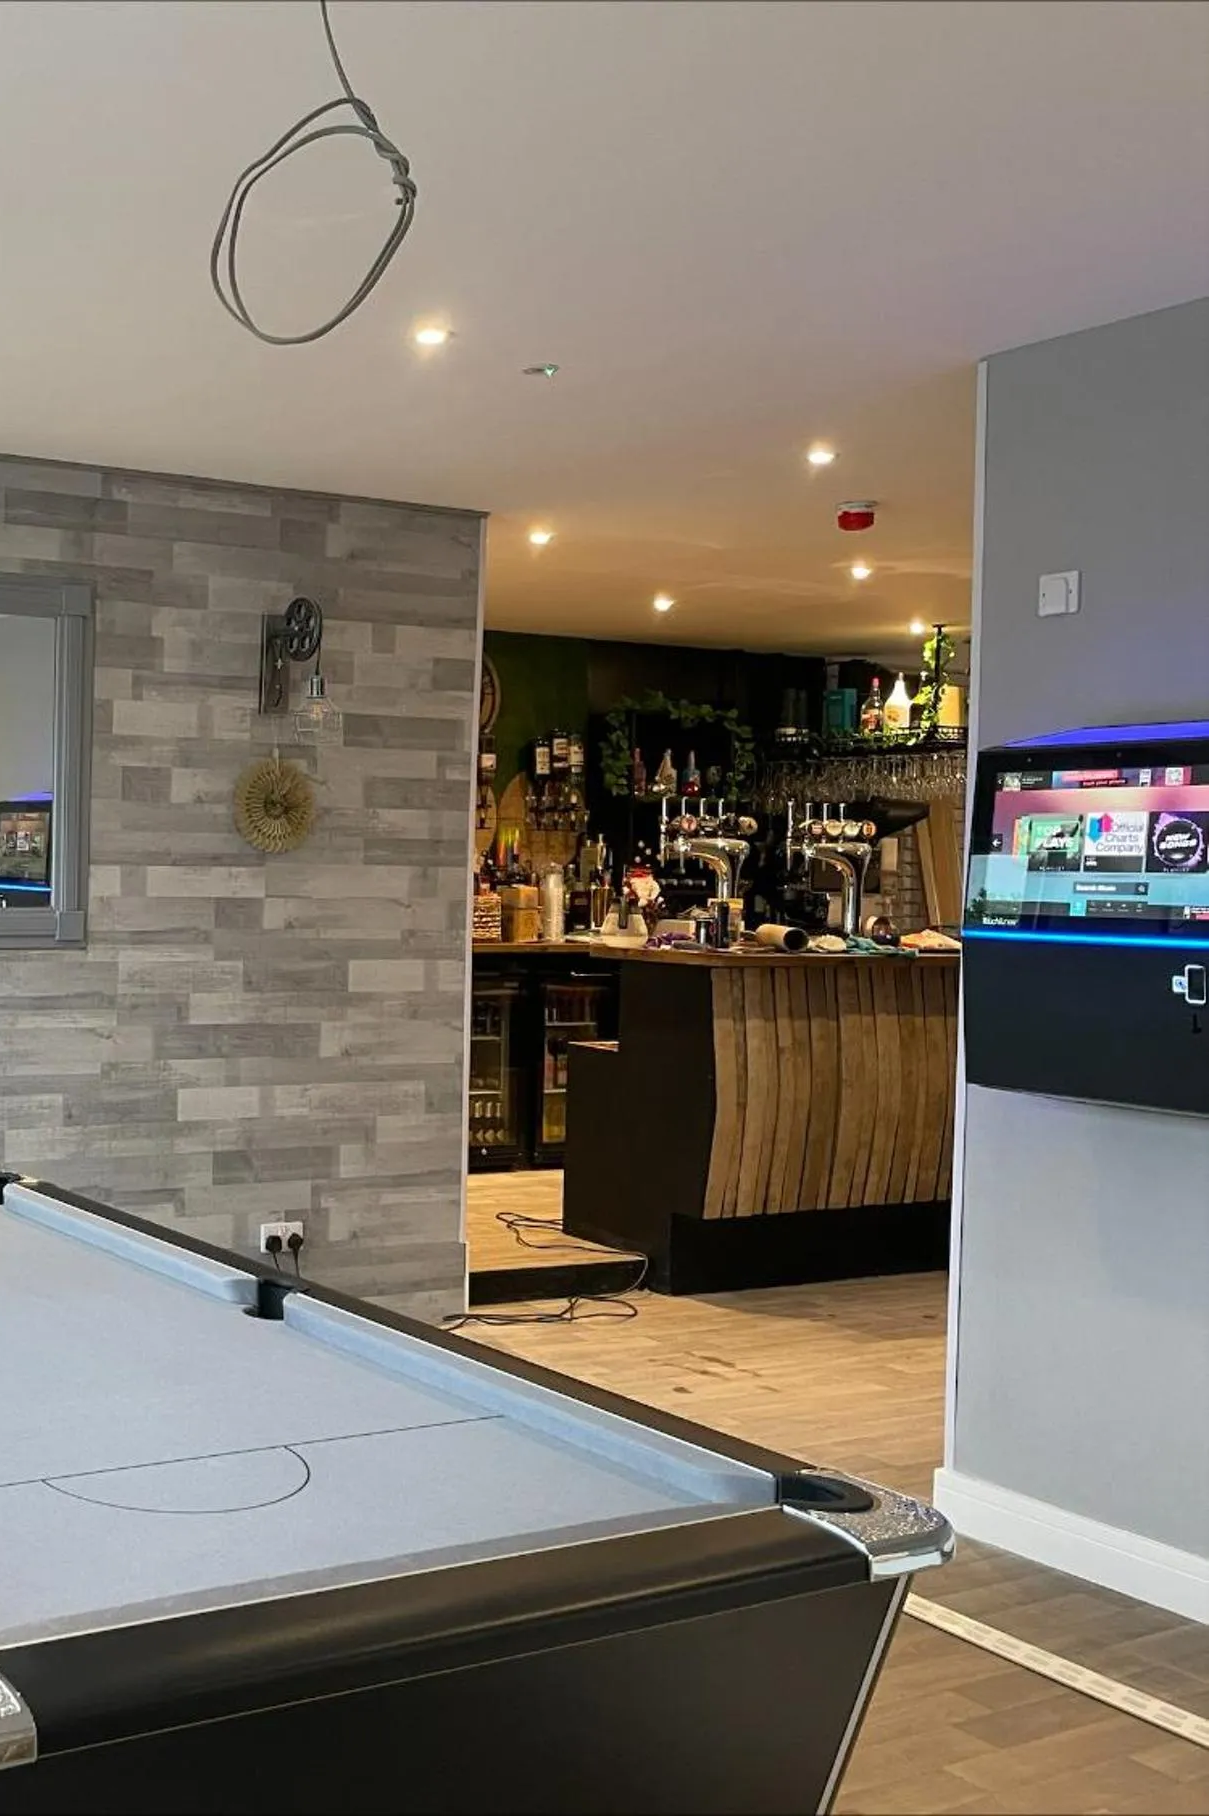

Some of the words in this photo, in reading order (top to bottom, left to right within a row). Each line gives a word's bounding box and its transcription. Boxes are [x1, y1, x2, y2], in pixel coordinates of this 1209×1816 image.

[1112, 821, 1144, 832] Official
[1105, 833, 1139, 843] Charts
[1165, 833, 1191, 841] NEW
[1096, 842, 1143, 854] Company
